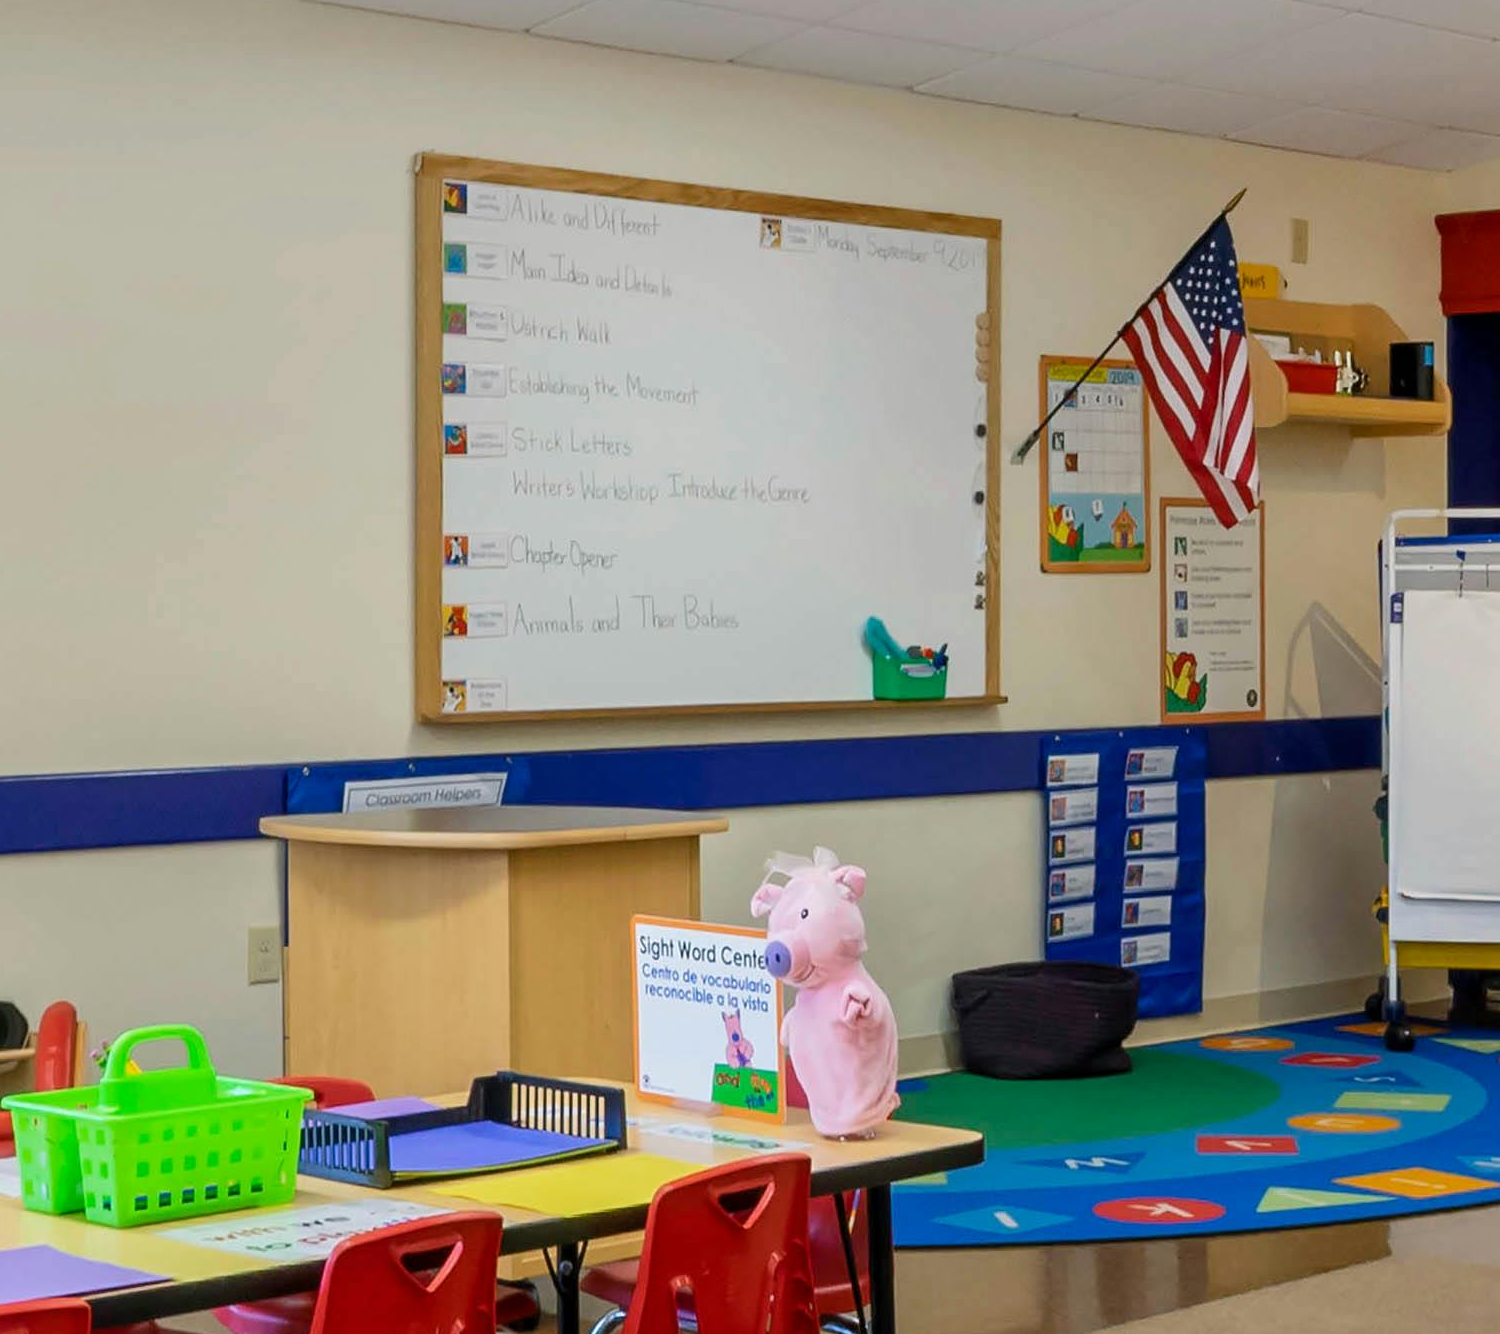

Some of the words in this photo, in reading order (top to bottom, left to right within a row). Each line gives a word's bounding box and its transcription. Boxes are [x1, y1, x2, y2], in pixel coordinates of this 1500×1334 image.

[509, 194, 556, 225] Alike
[564, 208, 588, 230] and
[594, 202, 661, 236] Different
[816, 225, 860, 261] Monday
[867, 233, 927, 263] September
[510, 249, 546, 280] Main
[550, 253, 590, 285] Idea
[596, 266, 621, 290] and
[624, 265, 672, 297] Details
[510, 316, 569, 342] Ostrich
[577, 318, 612, 345] Walk
[509, 367, 590, 403] Establishing
[595, 374, 620, 398] the
[626, 374, 699, 405] Movement
[512, 427, 562, 453] Stick
[570, 429, 633, 456] Letters
[580, 469, 659, 506] Workshop
[667, 472, 737, 501] Introduce
[742, 475, 768, 505] the
[768, 475, 810, 505] Genre
[510, 535, 567, 574] Chapter
[569, 539, 619, 576] Opener
[512, 595, 584, 636] Animals
[592, 596, 620, 634] and
[630, 595, 676, 629] Their
[684, 595, 739, 631] Babies
[366, 790, 432, 808] Classroom
[434, 786, 482, 803] Helpers
[640, 935, 674, 960] Sight
[677, 941, 716, 963] Word
[721, 946, 768, 970] Cente
[642, 963, 679, 982] Centro
[682, 968, 698, 984] de
[701, 973, 771, 994] vocabulario
[645, 983, 713, 1005] reconocible
[717, 995, 725, 1006] a
[728, 994, 738, 1009] la
[742, 998, 768, 1012] vista
